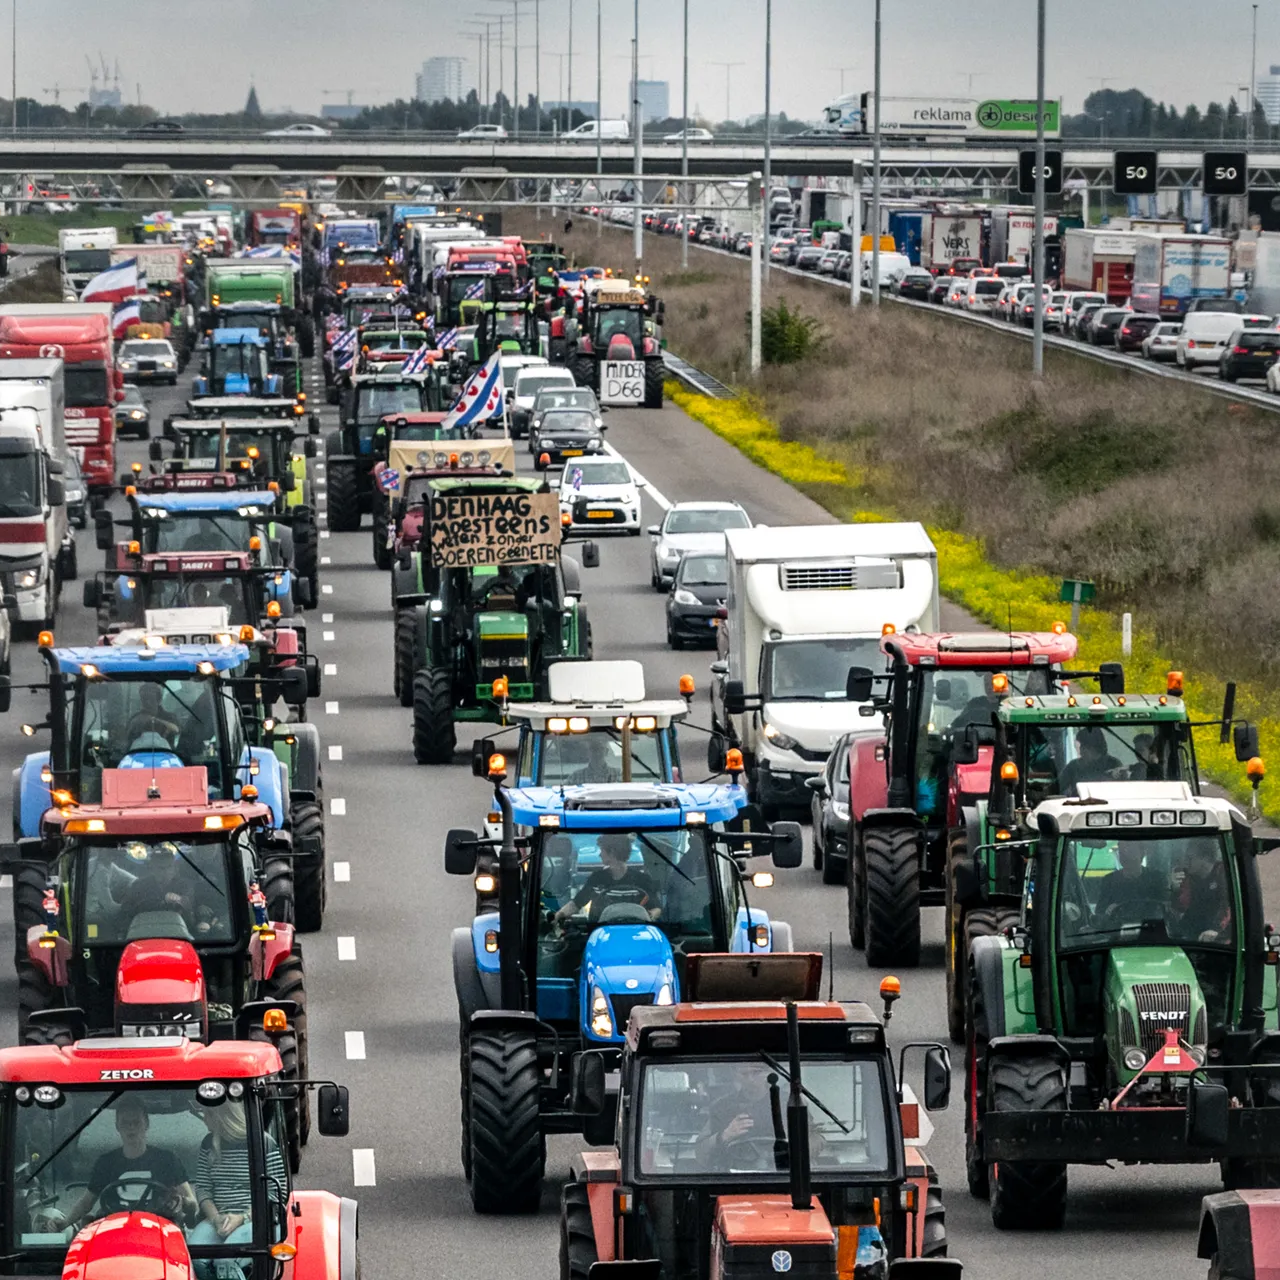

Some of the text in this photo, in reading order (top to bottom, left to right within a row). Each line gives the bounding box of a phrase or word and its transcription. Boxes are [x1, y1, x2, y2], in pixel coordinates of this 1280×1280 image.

[913, 107, 972, 122] reklama
[1125, 166, 1147, 179] 50
[1214, 167, 1237, 180] 50
[942, 237, 970, 250] VERS
[608, 380, 642, 398] D66
[1140, 1011, 1187, 1021] FENDT
[100, 1068, 155, 1080] ZETOR
